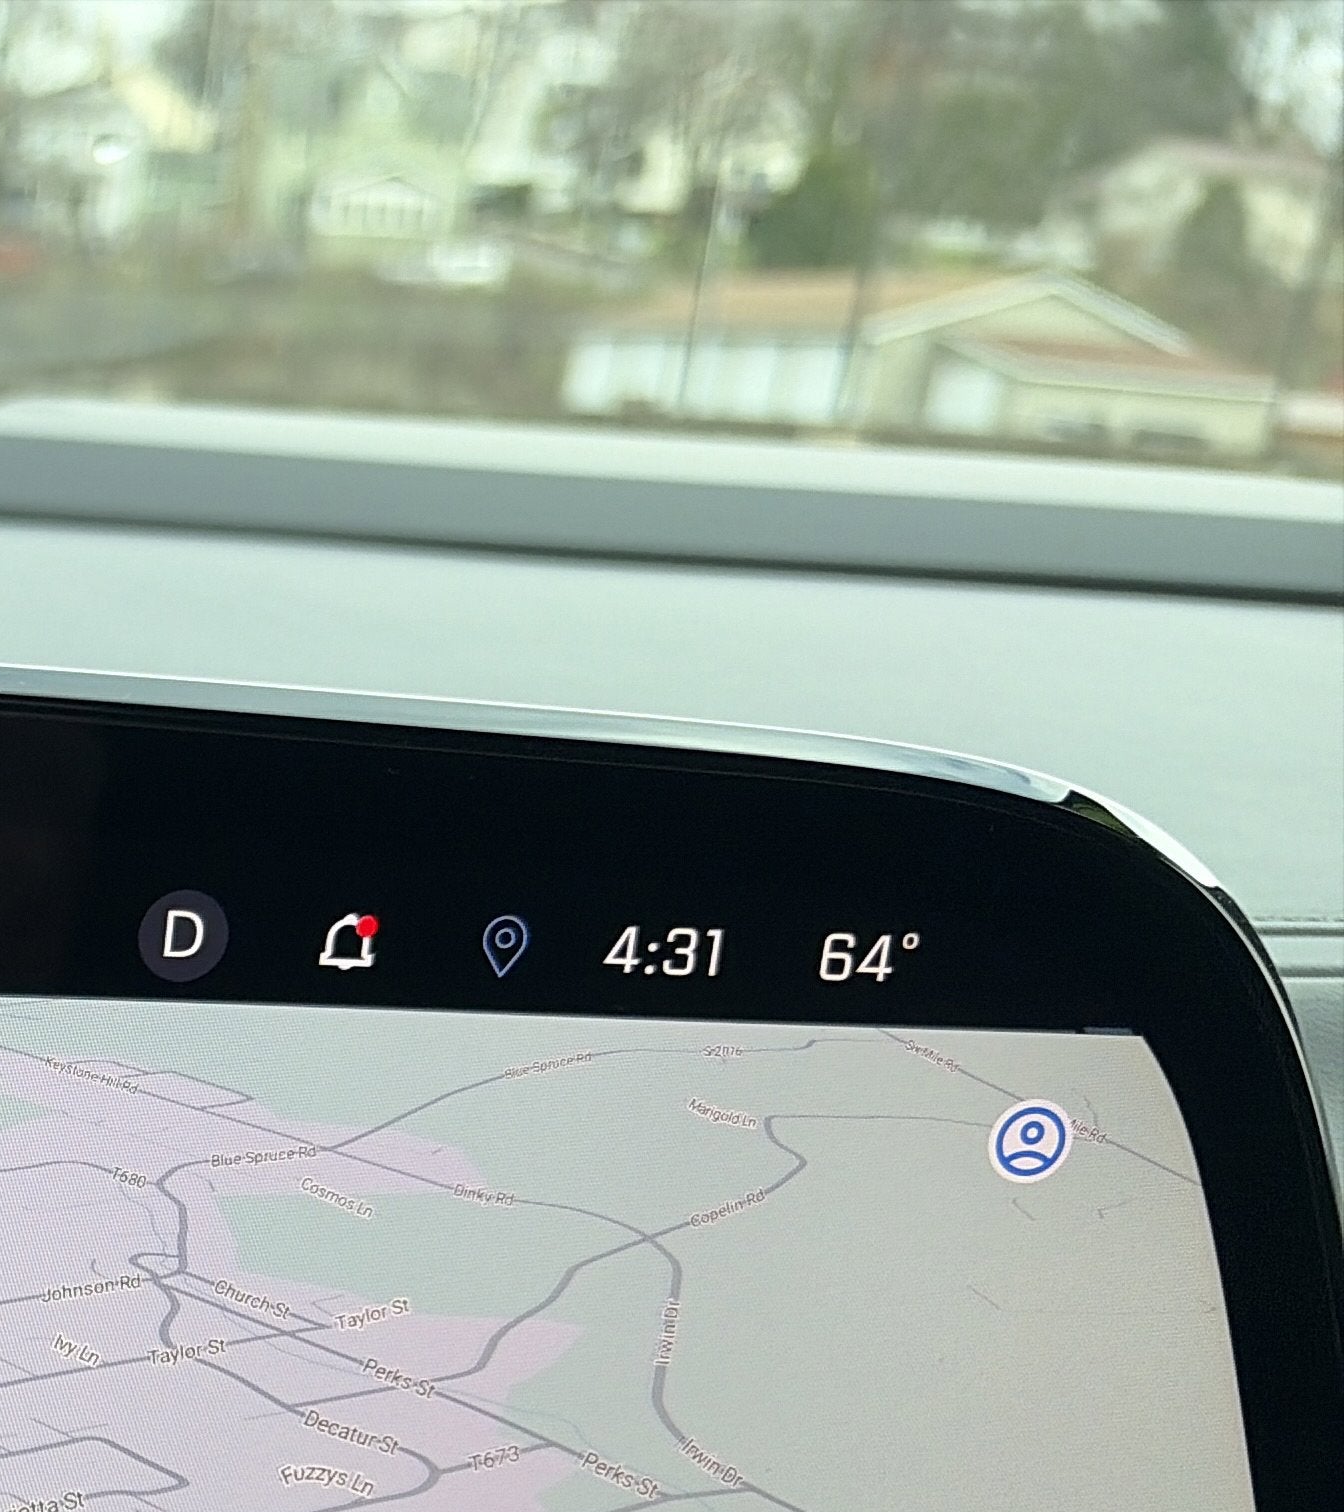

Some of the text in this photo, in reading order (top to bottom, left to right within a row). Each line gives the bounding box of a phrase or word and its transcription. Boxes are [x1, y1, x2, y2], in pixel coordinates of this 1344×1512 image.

[163, 910, 204, 958] D
[604, 927, 725, 977] 4:31
[819, 931, 922, 984] 64°
[742, 1116, 757, 1129] Ln
[210, 1145, 317, 1170] Blue Spruce Rd
[112, 1166, 148, 1188] T680
[453, 1182, 514, 1207] Dinky Rd
[300, 1176, 373, 1219] Cosmos Ln
[740, 1187, 766, 1208] Rd
[42, 1273, 142, 1305] Johnson Rd
[213, 1279, 291, 1321] Church St
[335, 1298, 410, 1332] Taylor St
[654, 1298, 681, 1366] Irwin Dr
[51, 1333, 100, 1367] Ivy Ln
[148, 1338, 226, 1367] Taylor St
[362, 1357, 436, 1400] Perks St
[302, 1410, 400, 1456] Decatur St
[469, 1445, 521, 1472] T673
[581, 1451, 660, 1500] Perks St
[680, 1437, 745, 1489] Irwin Dr
[279, 1463, 375, 1499] Fuzzys Ln
[60, 1490, 85, 1511] St
